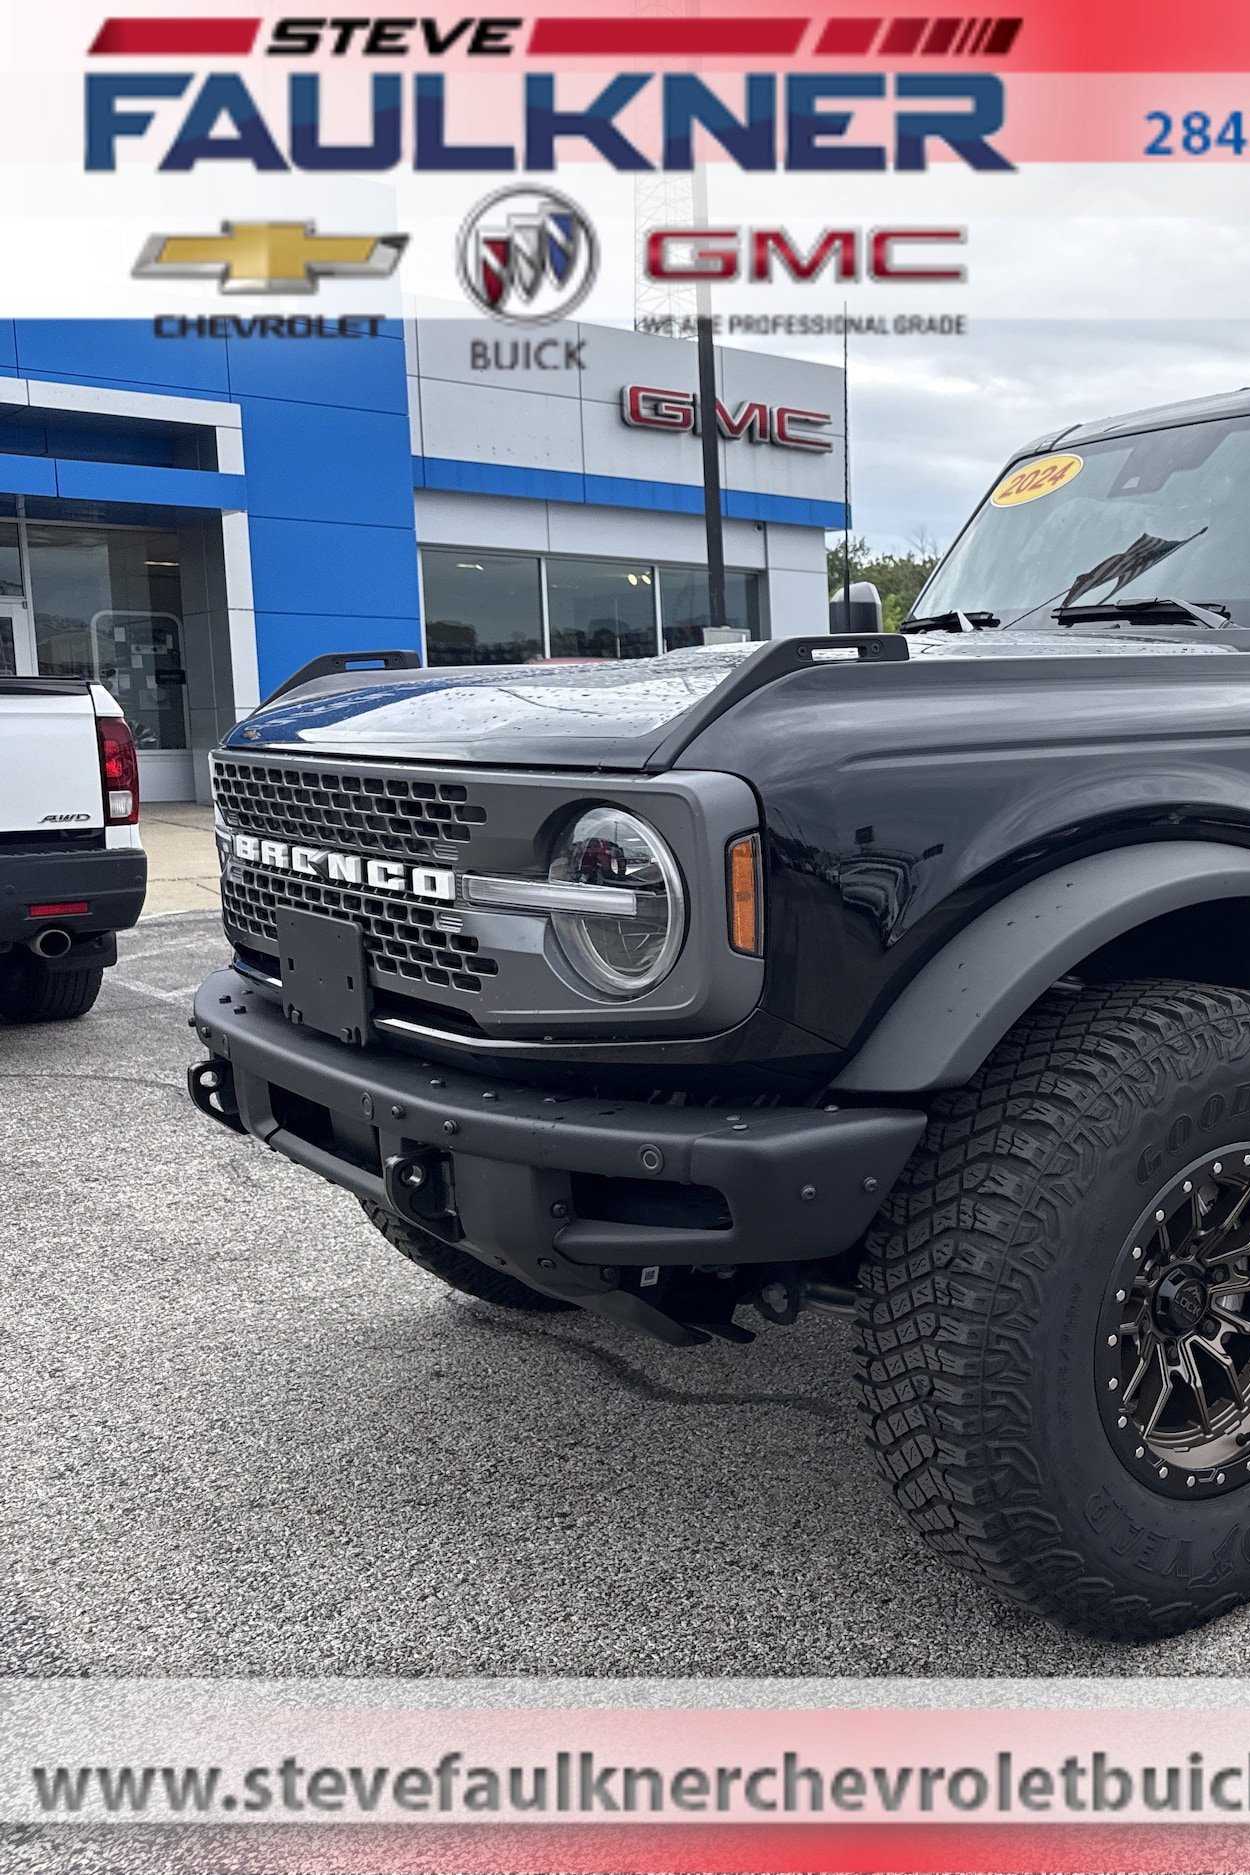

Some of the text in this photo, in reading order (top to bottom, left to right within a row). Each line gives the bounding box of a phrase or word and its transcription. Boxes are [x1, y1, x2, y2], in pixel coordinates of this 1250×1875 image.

[620, 385, 833, 453] GMC
[997, 461, 1076, 500] 2024
[37, 812, 91, 825] AWD
[234, 833, 457, 901] BRONCO
